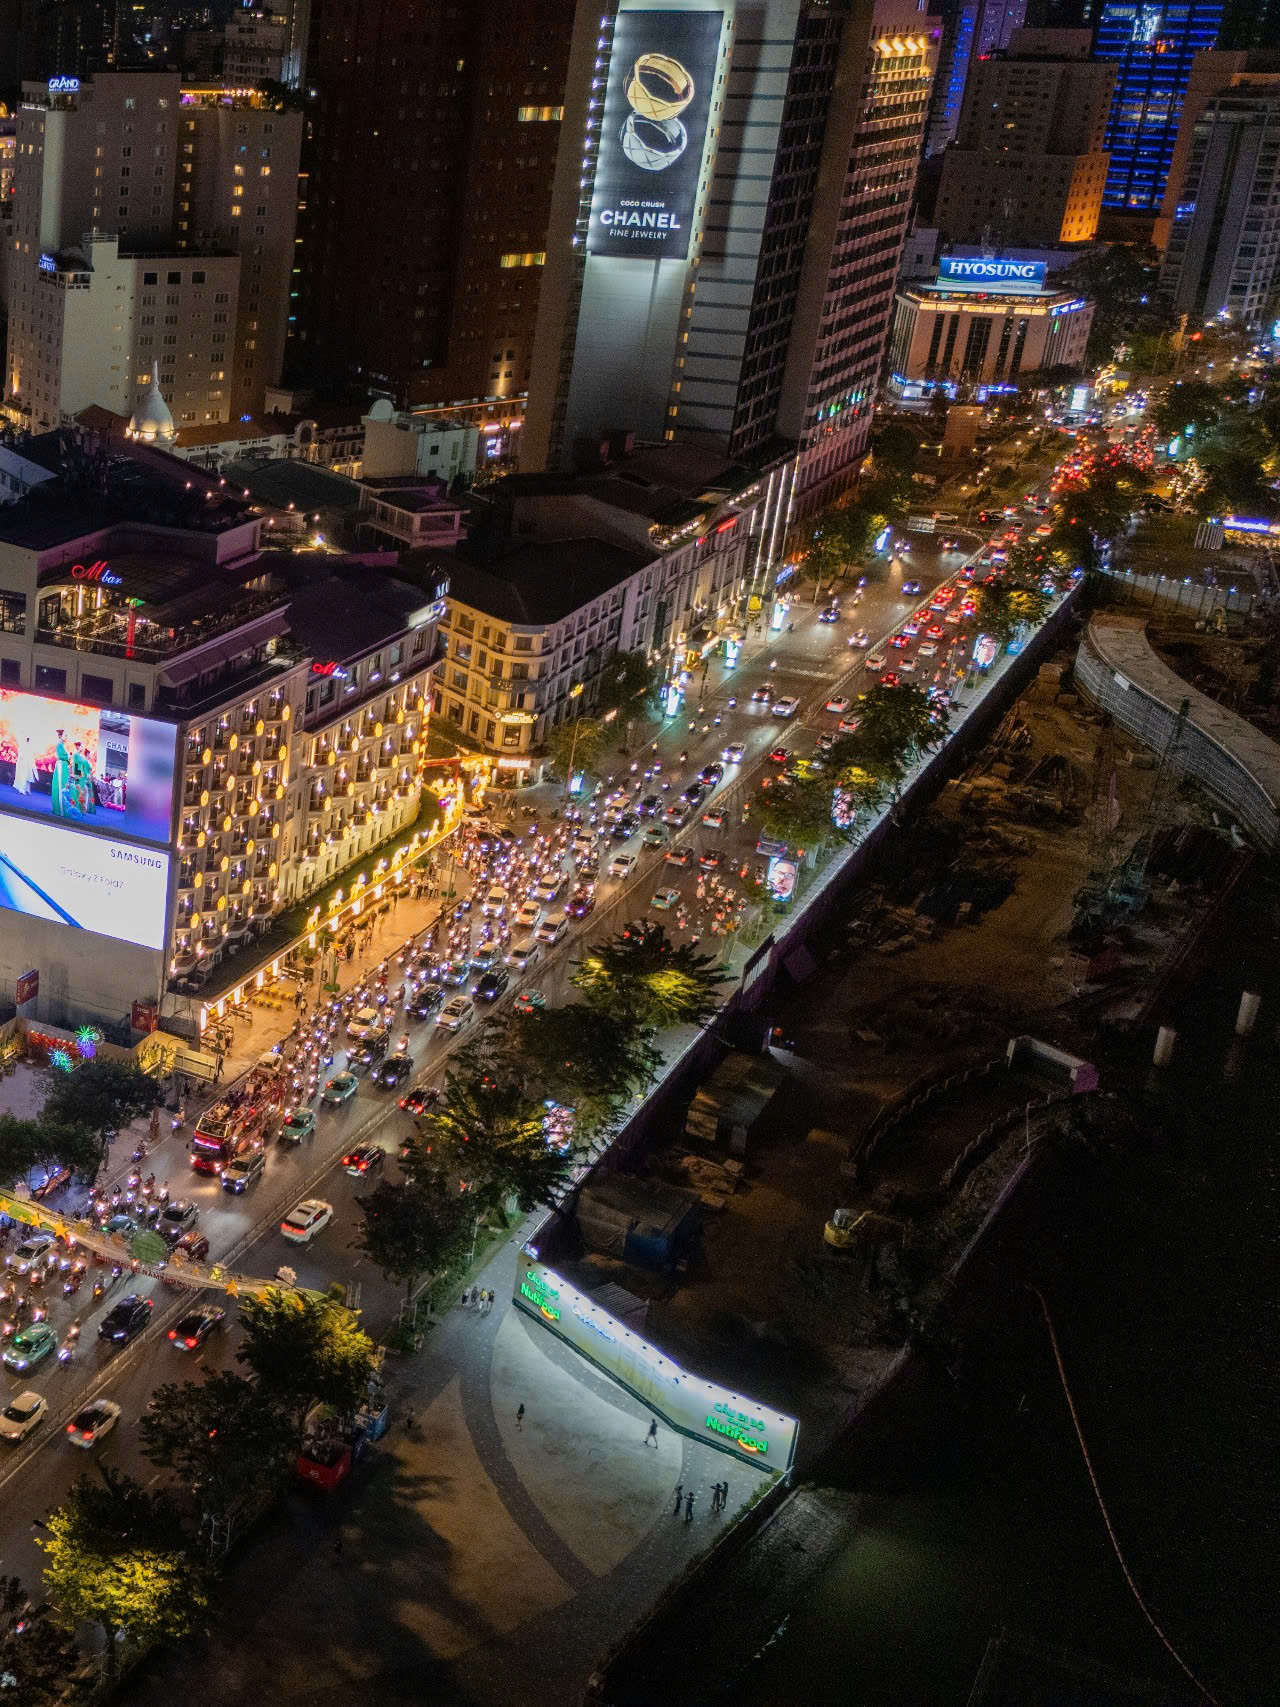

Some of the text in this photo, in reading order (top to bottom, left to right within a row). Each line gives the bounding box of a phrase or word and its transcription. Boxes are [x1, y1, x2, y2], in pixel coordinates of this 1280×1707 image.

[49, 76, 79, 88] GRAND
[600, 210, 681, 229] CHANEL
[609, 228, 667, 240] FINE JEWELRY
[949, 262, 1035, 278] HYOSUNG
[110, 849, 162, 869] SAMSUNG
[520, 1283, 560, 1320] Nutifood
[705, 1415, 768, 1453] Nutifood
